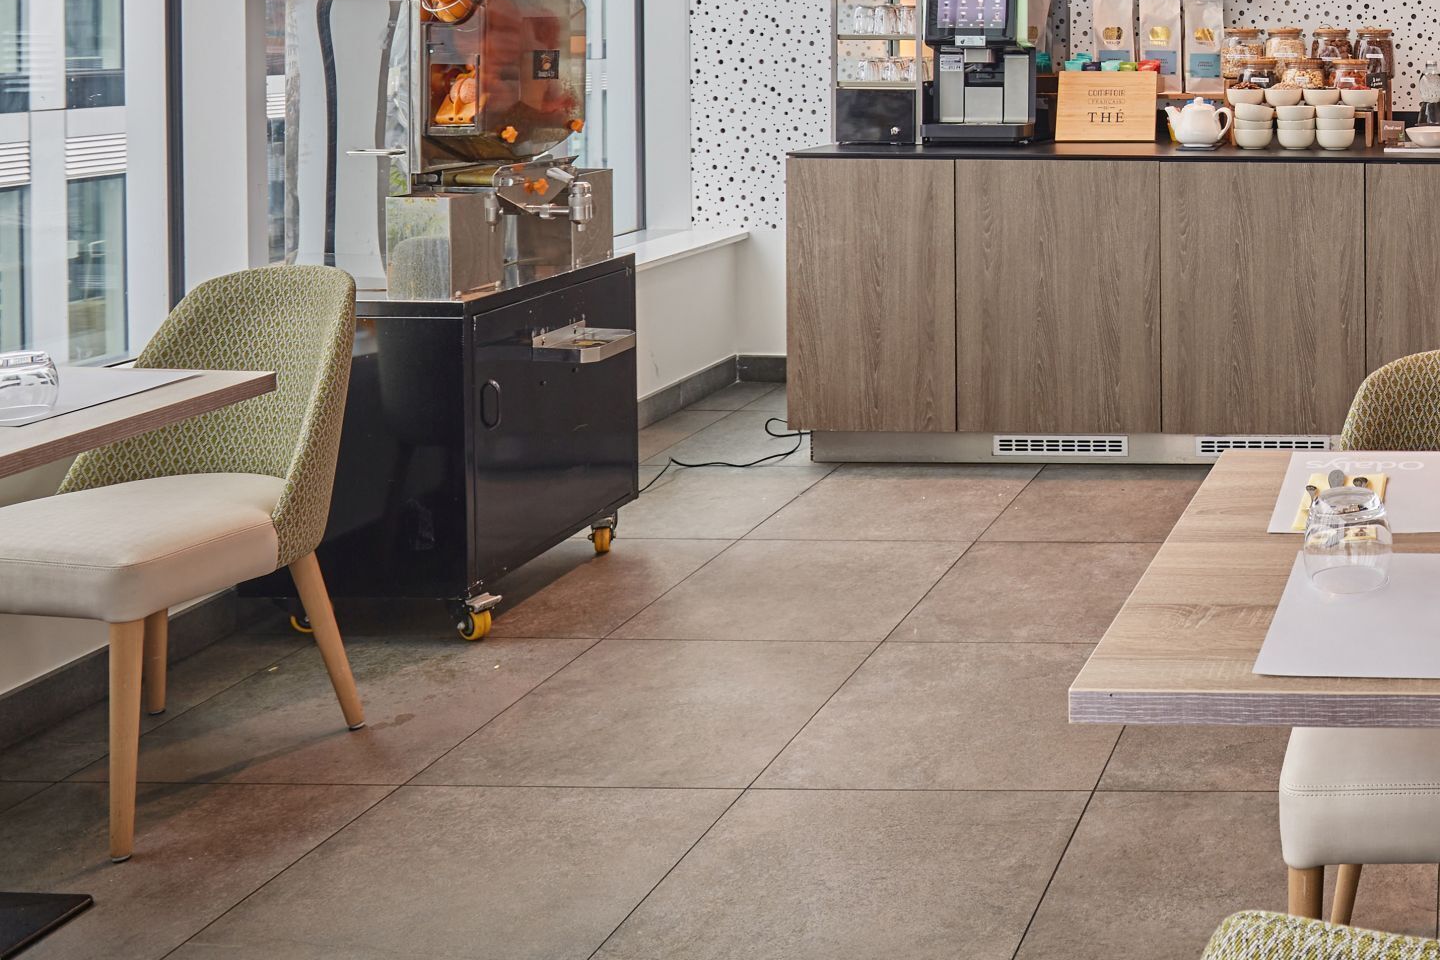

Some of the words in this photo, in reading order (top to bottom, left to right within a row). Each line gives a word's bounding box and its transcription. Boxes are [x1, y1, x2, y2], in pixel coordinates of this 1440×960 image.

[1088, 89, 1125, 97] COMPTOIR
[1088, 109, 1125, 123] THÉ
[1305, 457, 1425, 473] Odalys
